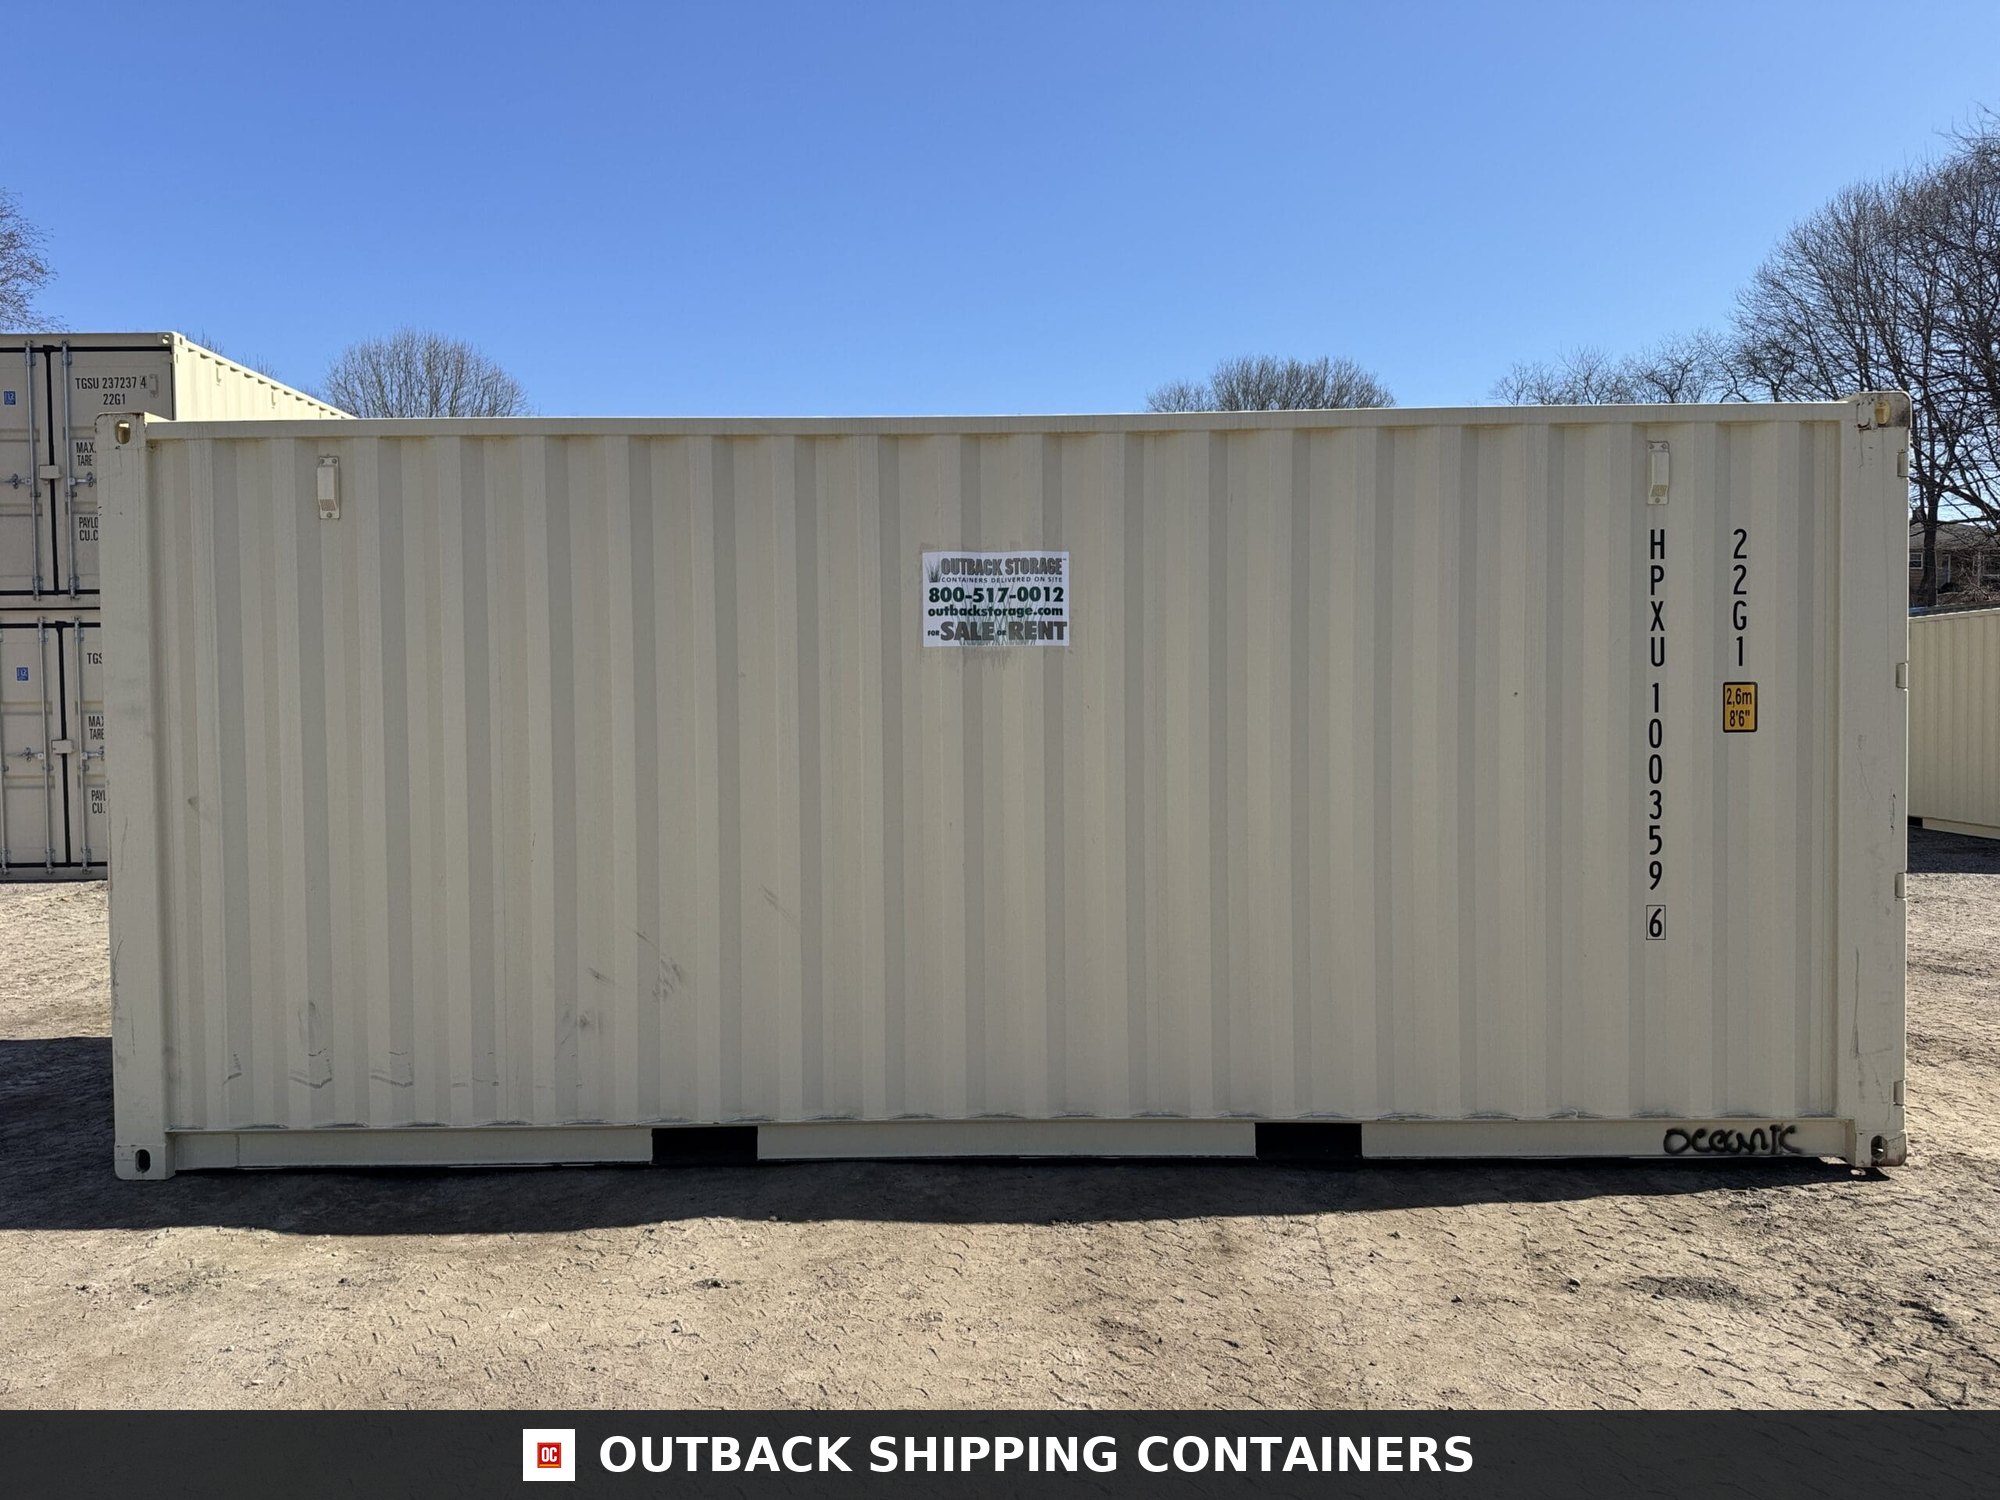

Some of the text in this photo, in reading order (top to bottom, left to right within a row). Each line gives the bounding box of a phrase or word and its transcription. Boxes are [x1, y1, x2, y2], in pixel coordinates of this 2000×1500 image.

[75, 376, 147, 390] TGSU 237237 4
[103, 393, 126, 405] 22G1
[77, 454, 93, 466] TARE
[941, 557, 1063, 575] OUTBACK STORAGE
[928, 586, 1065, 603] 800-517-0012
[1732, 528, 1748, 667] 22G1
[928, 604, 1064, 618] outbackstorage.com
[940, 621, 995, 641] SALE
[1008, 621, 1068, 641] RENT
[1727, 688, 1752, 707] 2,6m
[1648, 528, 1665, 938] HPXU 100359 6
